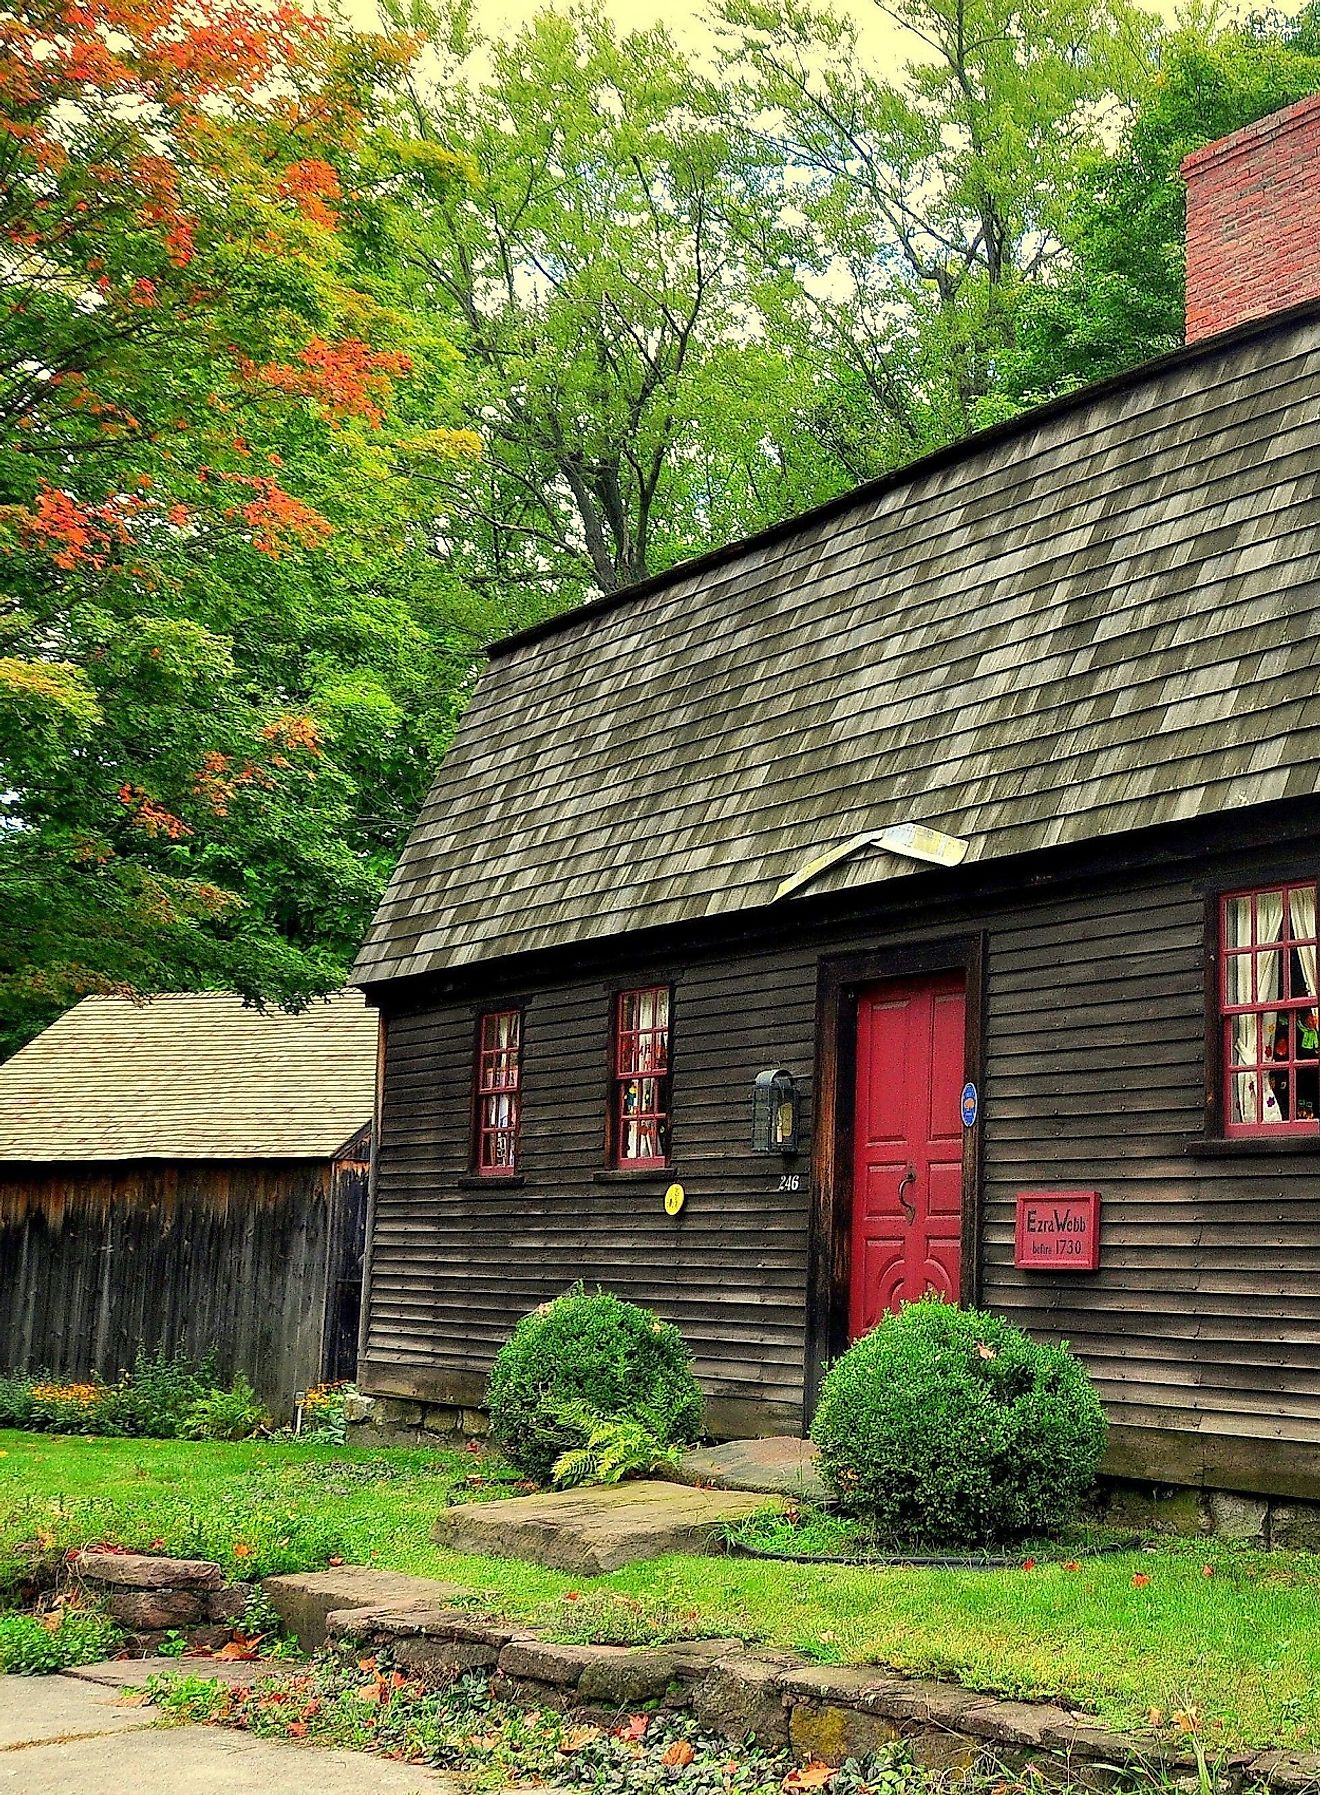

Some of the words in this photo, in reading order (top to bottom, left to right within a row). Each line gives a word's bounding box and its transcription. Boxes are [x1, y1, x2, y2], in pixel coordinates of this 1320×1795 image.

[779, 1175, 800, 1191] 246
[1027, 1209, 1054, 1233] Ezra
[1053, 1208, 1086, 1233] Webb
[1055, 1239, 1082, 1255] 1730
